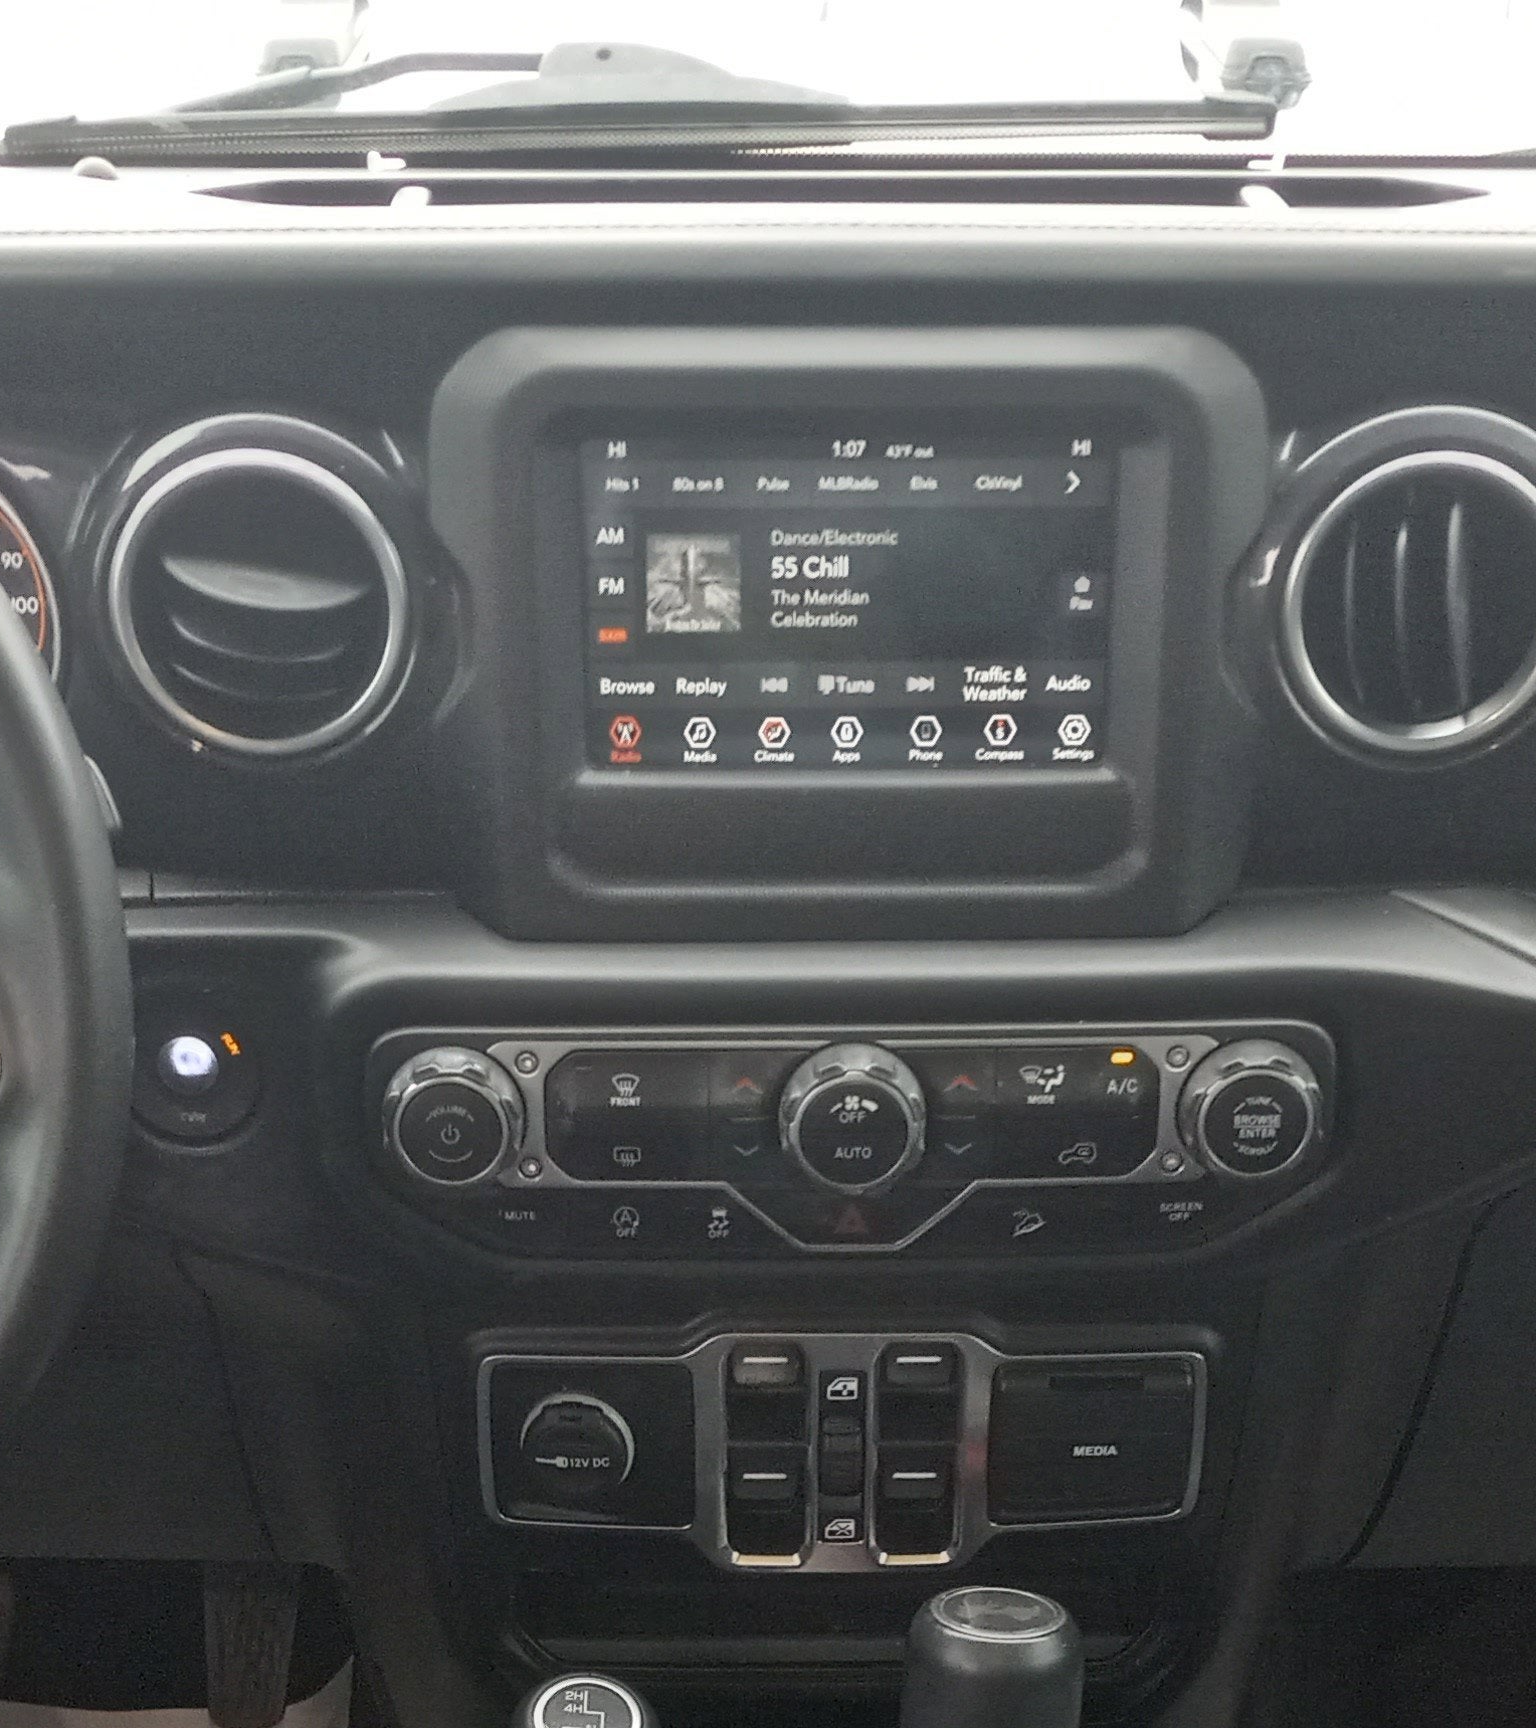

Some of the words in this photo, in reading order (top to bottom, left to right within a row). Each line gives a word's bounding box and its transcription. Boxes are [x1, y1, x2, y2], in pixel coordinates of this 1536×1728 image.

[607, 441, 627, 459] HI
[832, 439, 866, 458] 1:07
[1071, 439, 1092, 456] HI
[757, 476, 790, 491] Pulse
[596, 527, 625, 545] AM
[770, 529, 898, 546] Dance/Electronic
[1, 551, 23, 569] 90
[771, 556, 798, 579] 55
[803, 555, 850, 578] Chill
[598, 577, 625, 595] FM
[771, 589, 801, 605] The
[804, 588, 870, 605] Meridian
[770, 612, 858, 628] Celebration
[965, 666, 1011, 683] Traffic
[1014, 666, 1027, 683] &
[600, 677, 655, 695] Browse
[676, 677, 727, 697] Replay
[836, 676, 875, 693] Tune
[1045, 674, 1092, 691] Audio
[963, 684, 1028, 702] Weather
[683, 751, 717, 763] Media
[754, 750, 795, 763] Climate
[832, 750, 861, 764] Apps
[908, 750, 943, 762] Phone
[975, 748, 1025, 761] Compass
[1052, 748, 1095, 762] Settings
[1107, 1078, 1139, 1095] A/C
[610, 1096, 641, 1107] FRONT
[1027, 1095, 1056, 1105] MODE
[839, 1111, 866, 1124] OFF
[1233, 1114, 1281, 1128] BROWSE
[1238, 1129, 1277, 1139] ENTER
[834, 1147, 873, 1159] AUTO
[1160, 1202, 1203, 1213] SCREEN
[504, 1211, 536, 1221] MUTE
[1170, 1212, 1191, 1222] OFF
[616, 1228, 637, 1238] OFF
[708, 1229, 729, 1239] OFF
[1072, 1444, 1118, 1457] MEDIA
[569, 1458, 590, 1468] 12V
[592, 1458, 611, 1468] DC
[565, 1690, 583, 1701] 2H
[564, 1703, 582, 1714] 4H
